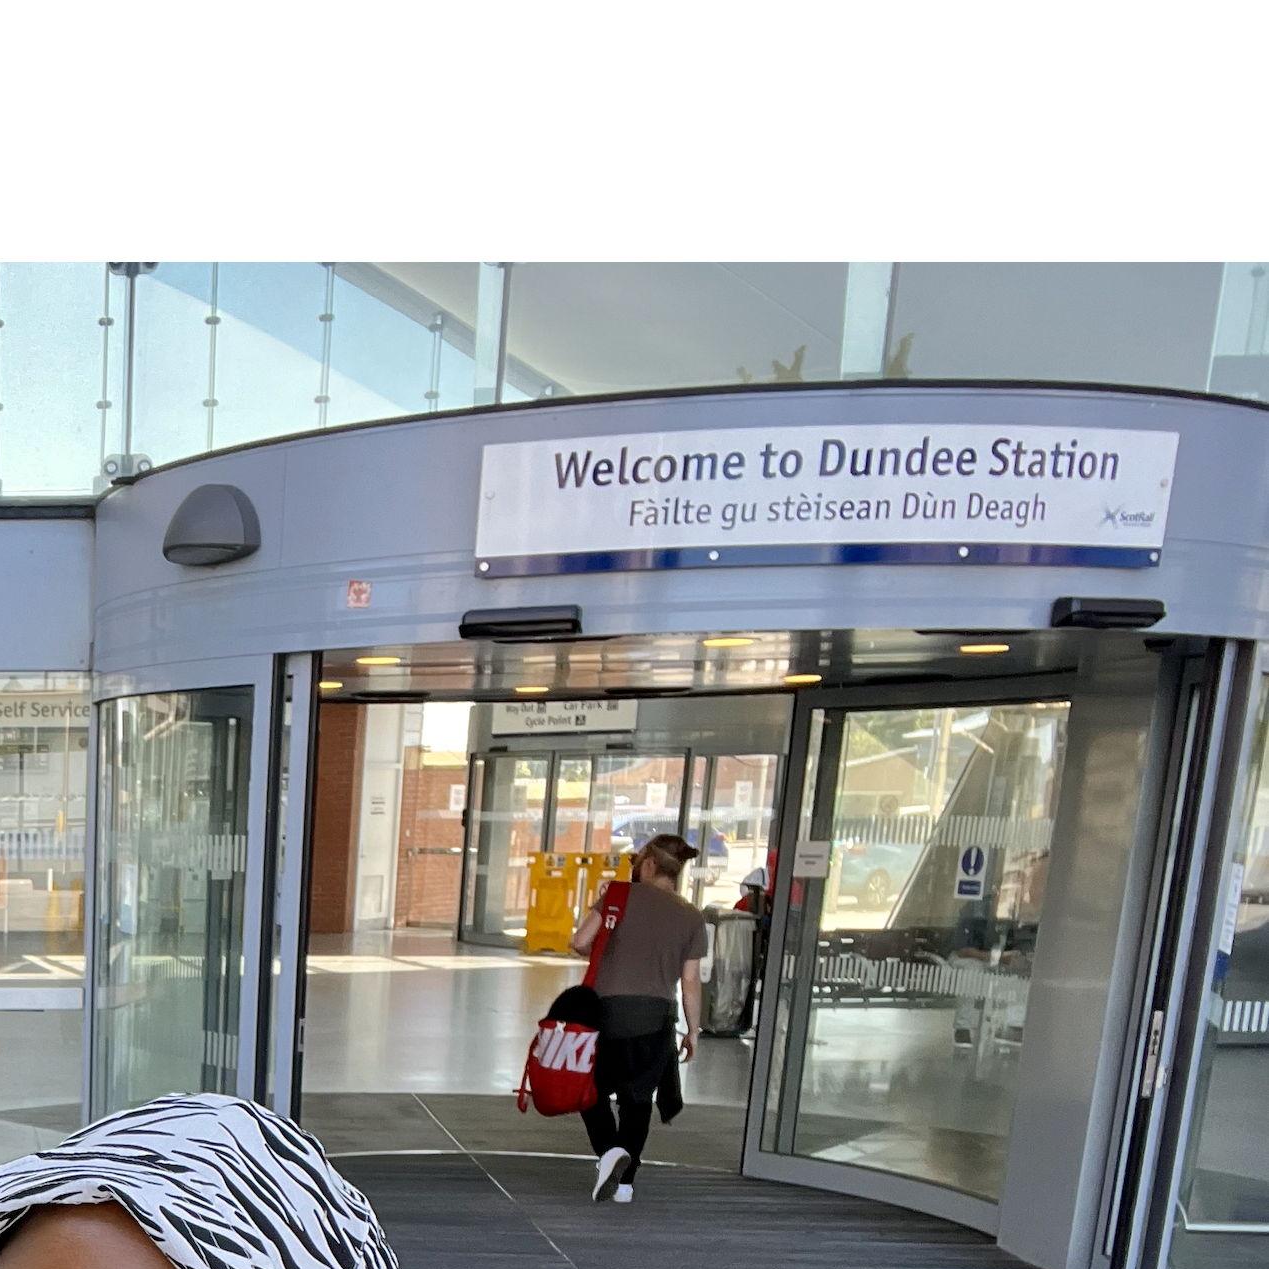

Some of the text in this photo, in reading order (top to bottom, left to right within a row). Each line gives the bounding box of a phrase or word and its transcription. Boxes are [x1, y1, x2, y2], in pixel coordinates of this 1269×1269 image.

[554, 435, 1120, 489] Welcome to Dundee Station
[629, 490, 1046, 530] Fàilte gu stèisean Dùn Deagh
[30, 700, 91, 718] Service
[548, 715, 572, 726] Point
